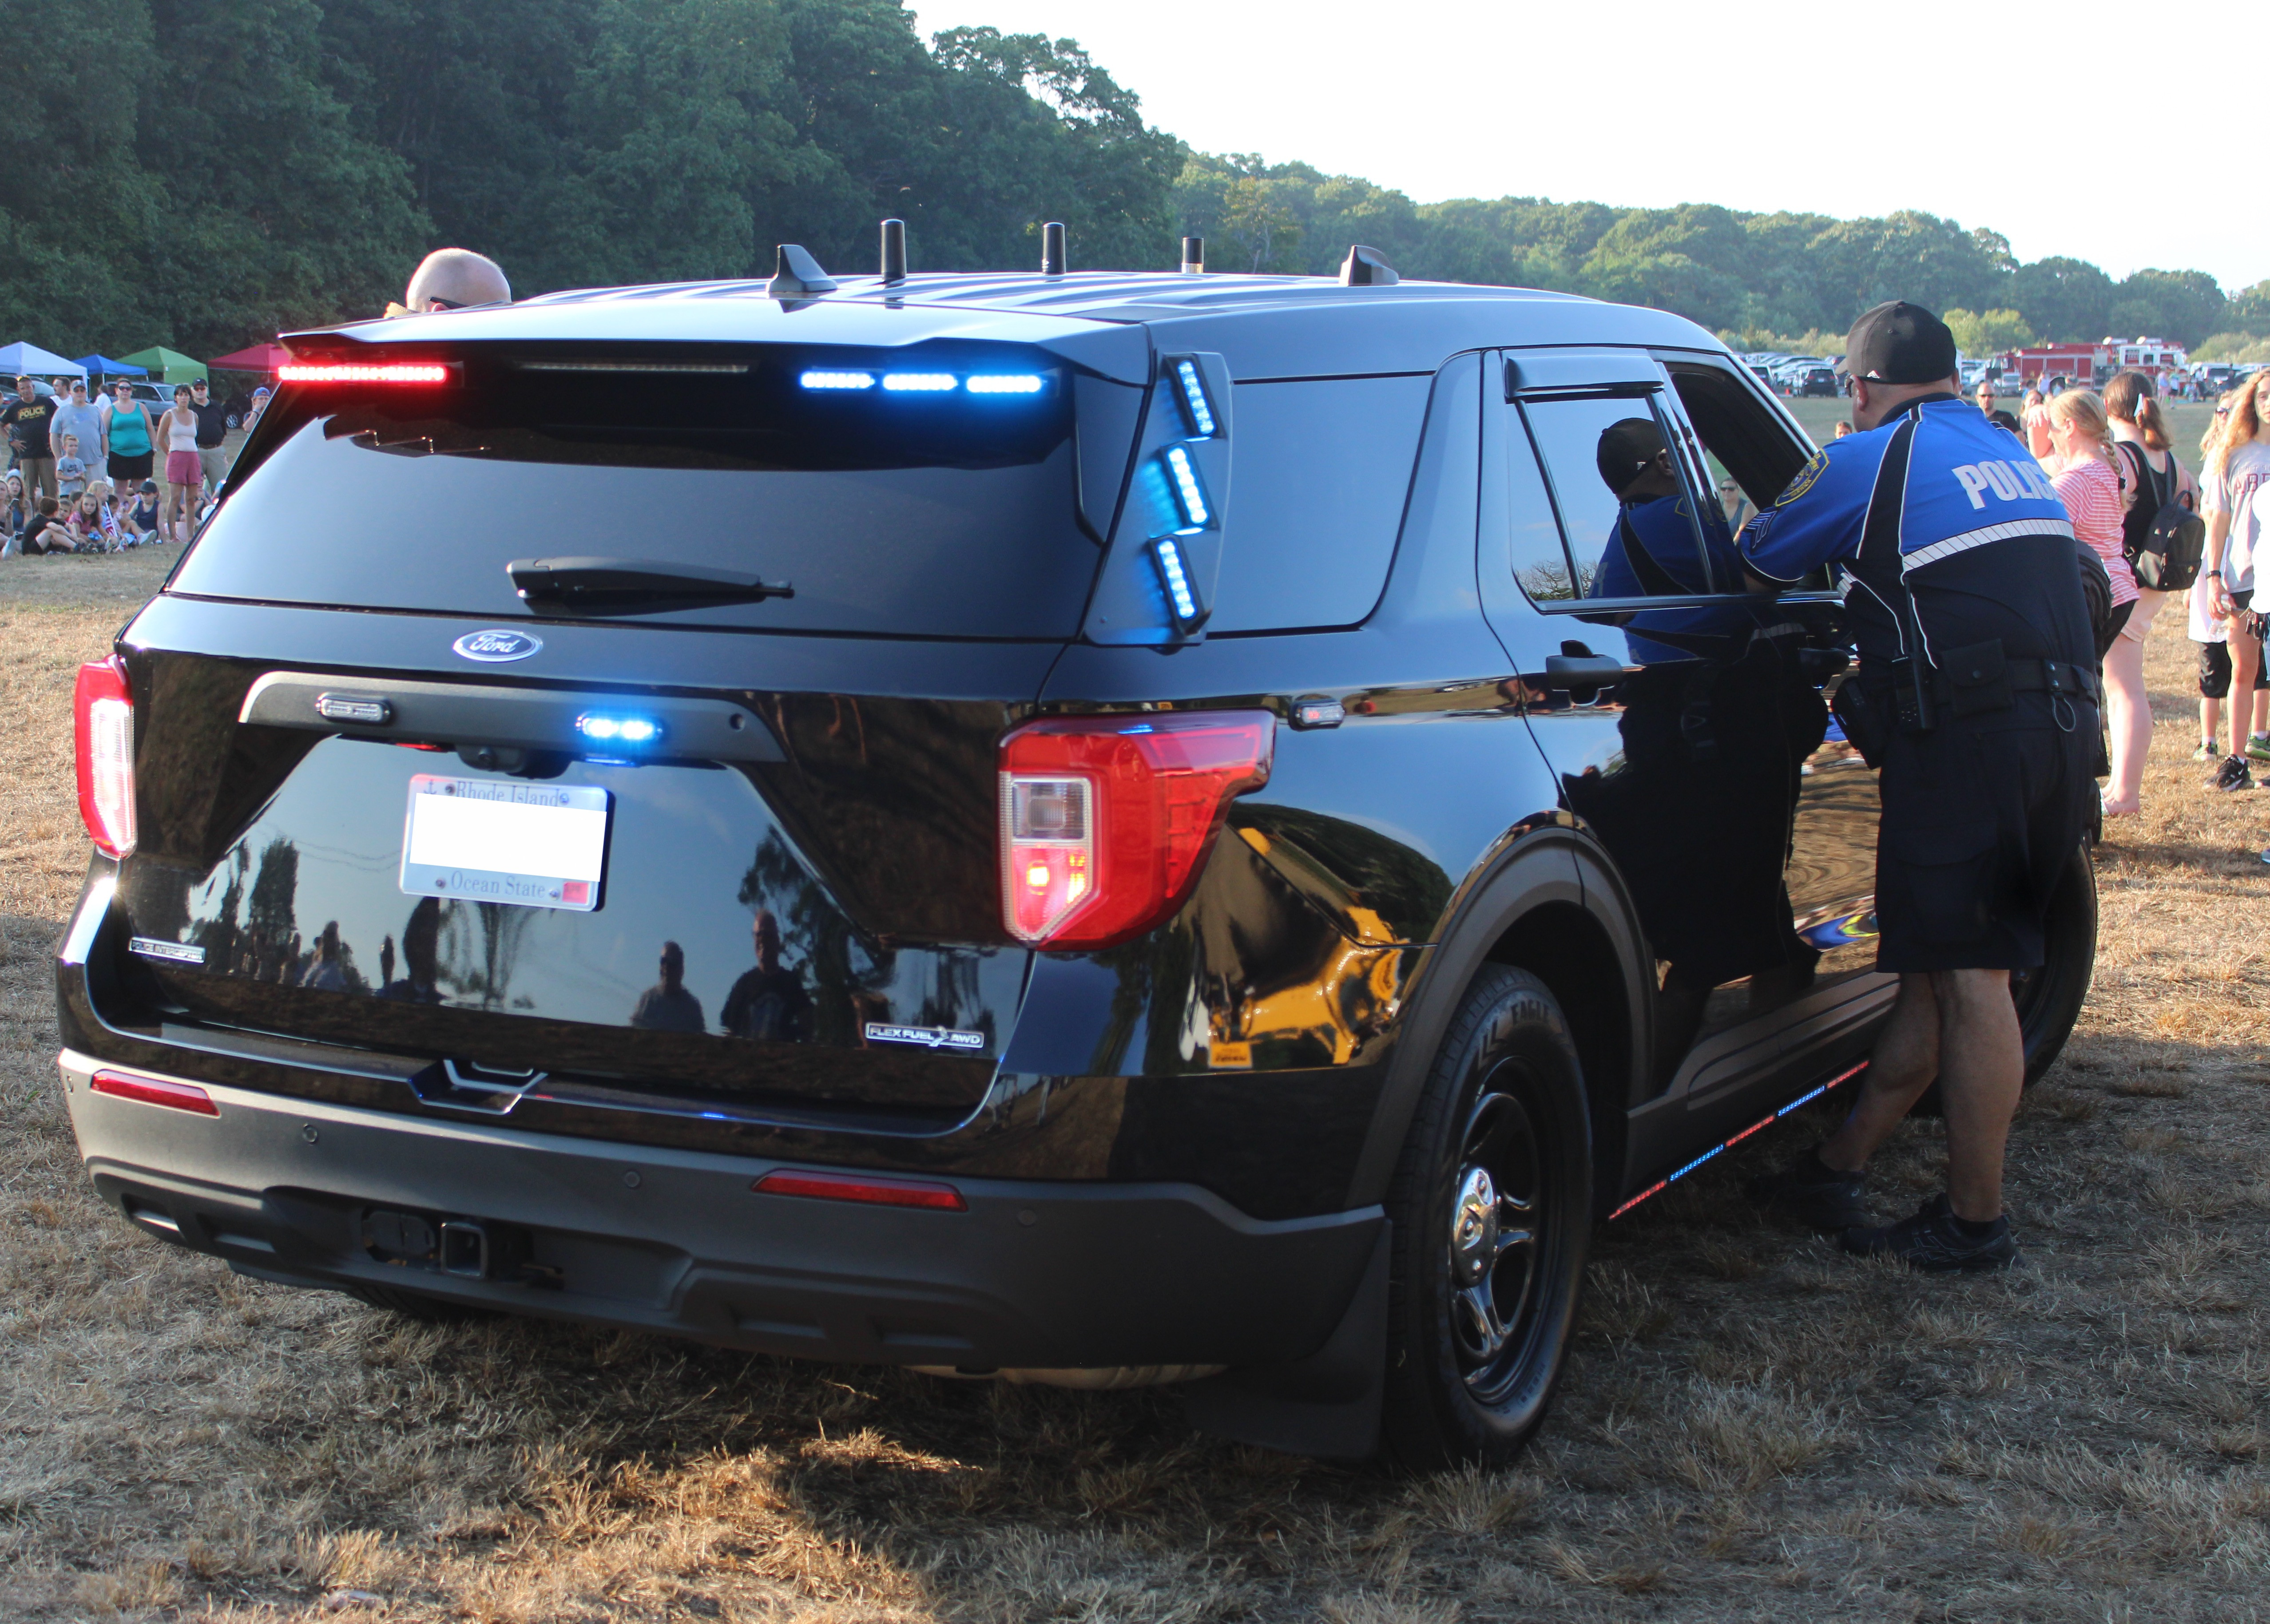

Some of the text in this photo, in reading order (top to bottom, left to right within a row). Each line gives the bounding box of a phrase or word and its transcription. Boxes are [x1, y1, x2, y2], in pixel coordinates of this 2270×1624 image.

[19, 406, 45, 420] POLICE
[470, 634, 520, 653] Ford
[456, 781, 560, 807] Rhode Island
[452, 871, 500, 893] Ocean
[505, 875, 546, 898] State
[949, 1034, 981, 1044] AWD
